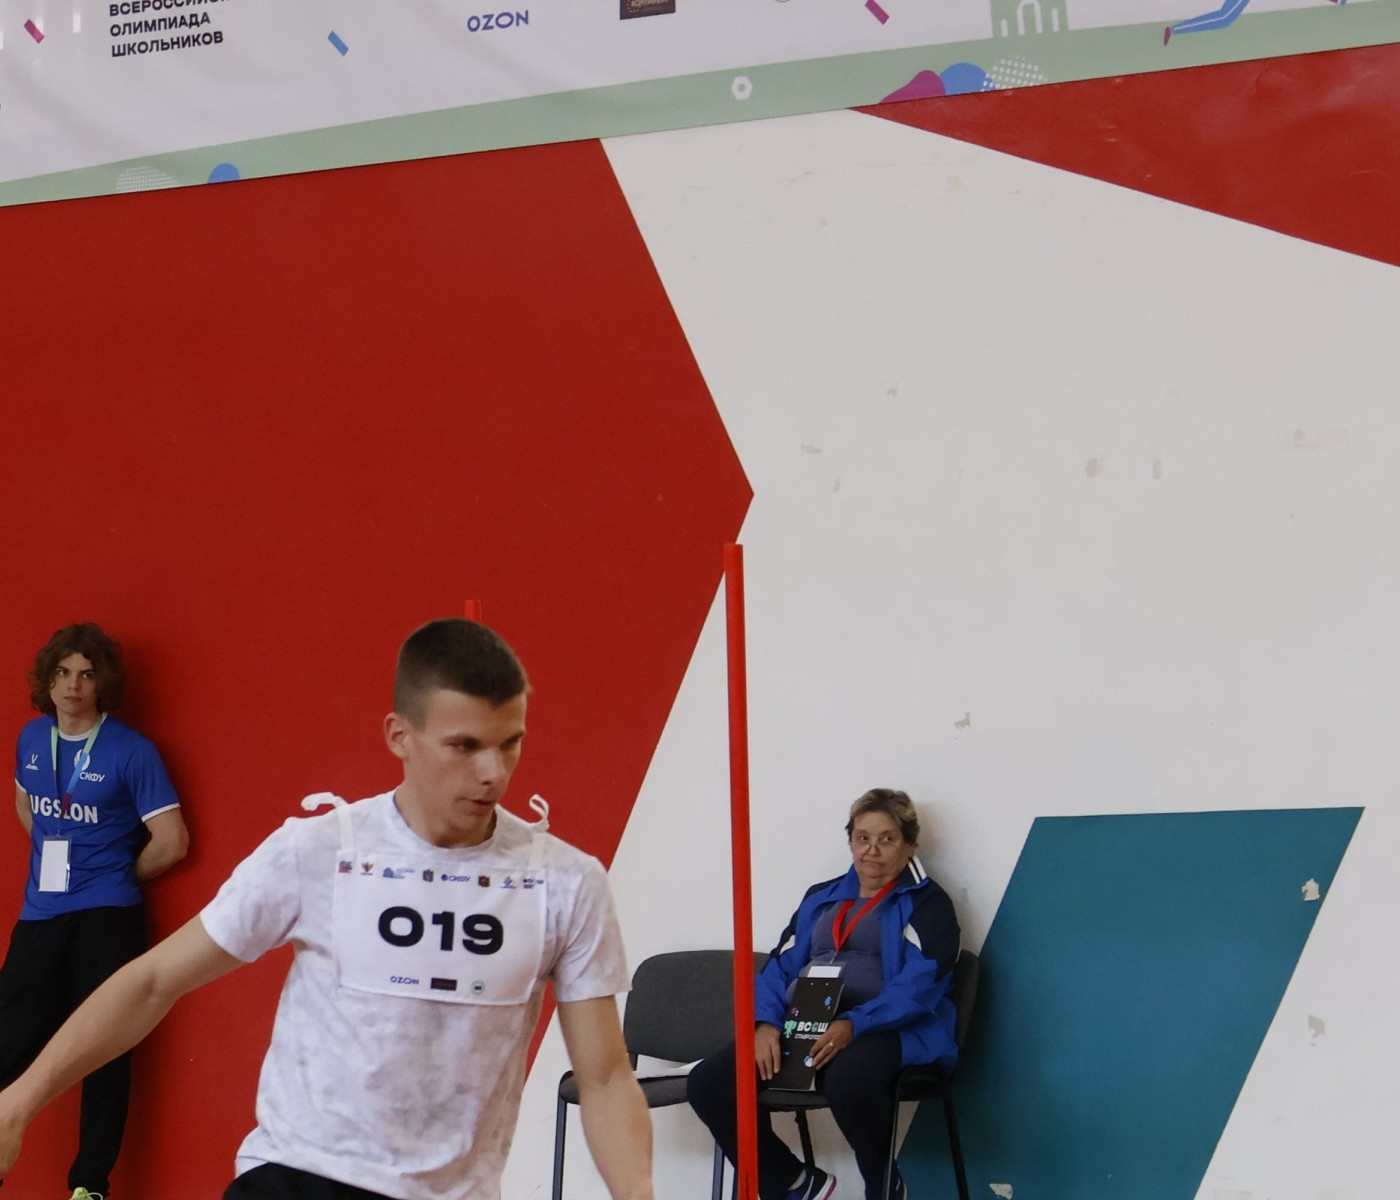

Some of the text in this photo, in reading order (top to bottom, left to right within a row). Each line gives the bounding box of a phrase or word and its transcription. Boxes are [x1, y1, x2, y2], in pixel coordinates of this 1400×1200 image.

[110, 12, 211, 37] ОЛИМПИАДА
[467, 10, 529, 32] OZON
[111, 31, 224, 57] ШКОЛЬНИКОВ
[80, 771, 105, 782] СКФУ
[378, 905, 504, 956] 019
